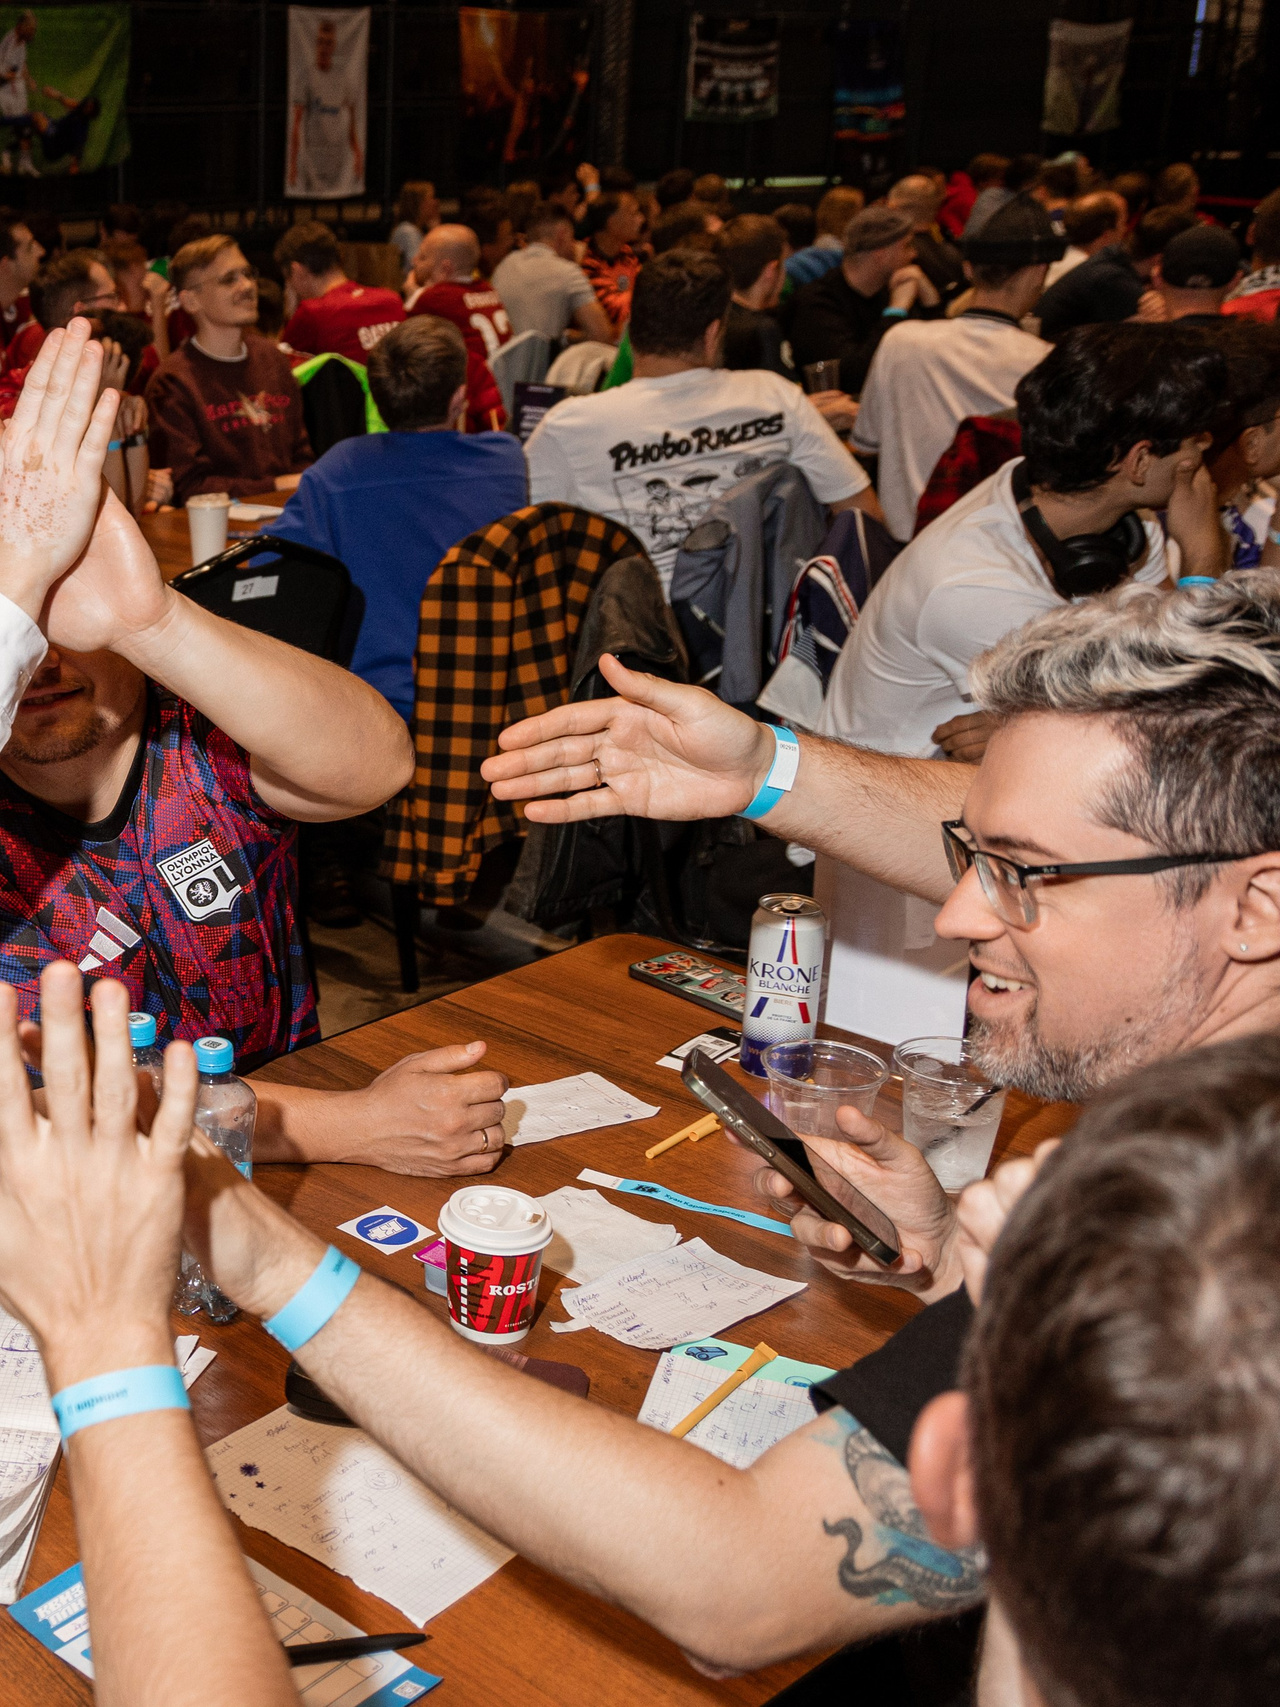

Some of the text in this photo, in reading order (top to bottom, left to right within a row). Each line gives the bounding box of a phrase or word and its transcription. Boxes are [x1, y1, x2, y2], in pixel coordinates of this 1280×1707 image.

[691, 411, 785, 455] RACERS
[241, 582, 255, 596] 27
[166, 844, 216, 872] OLYMPIQU
[170, 852, 219, 882] LYONNA
[749, 958, 820, 983] KRONE
[758, 979, 811, 994] BLANCHE
[33, 1581, 87, 1622] КВИЗ
[48, 1597, 88, 1629] ПЛИ
